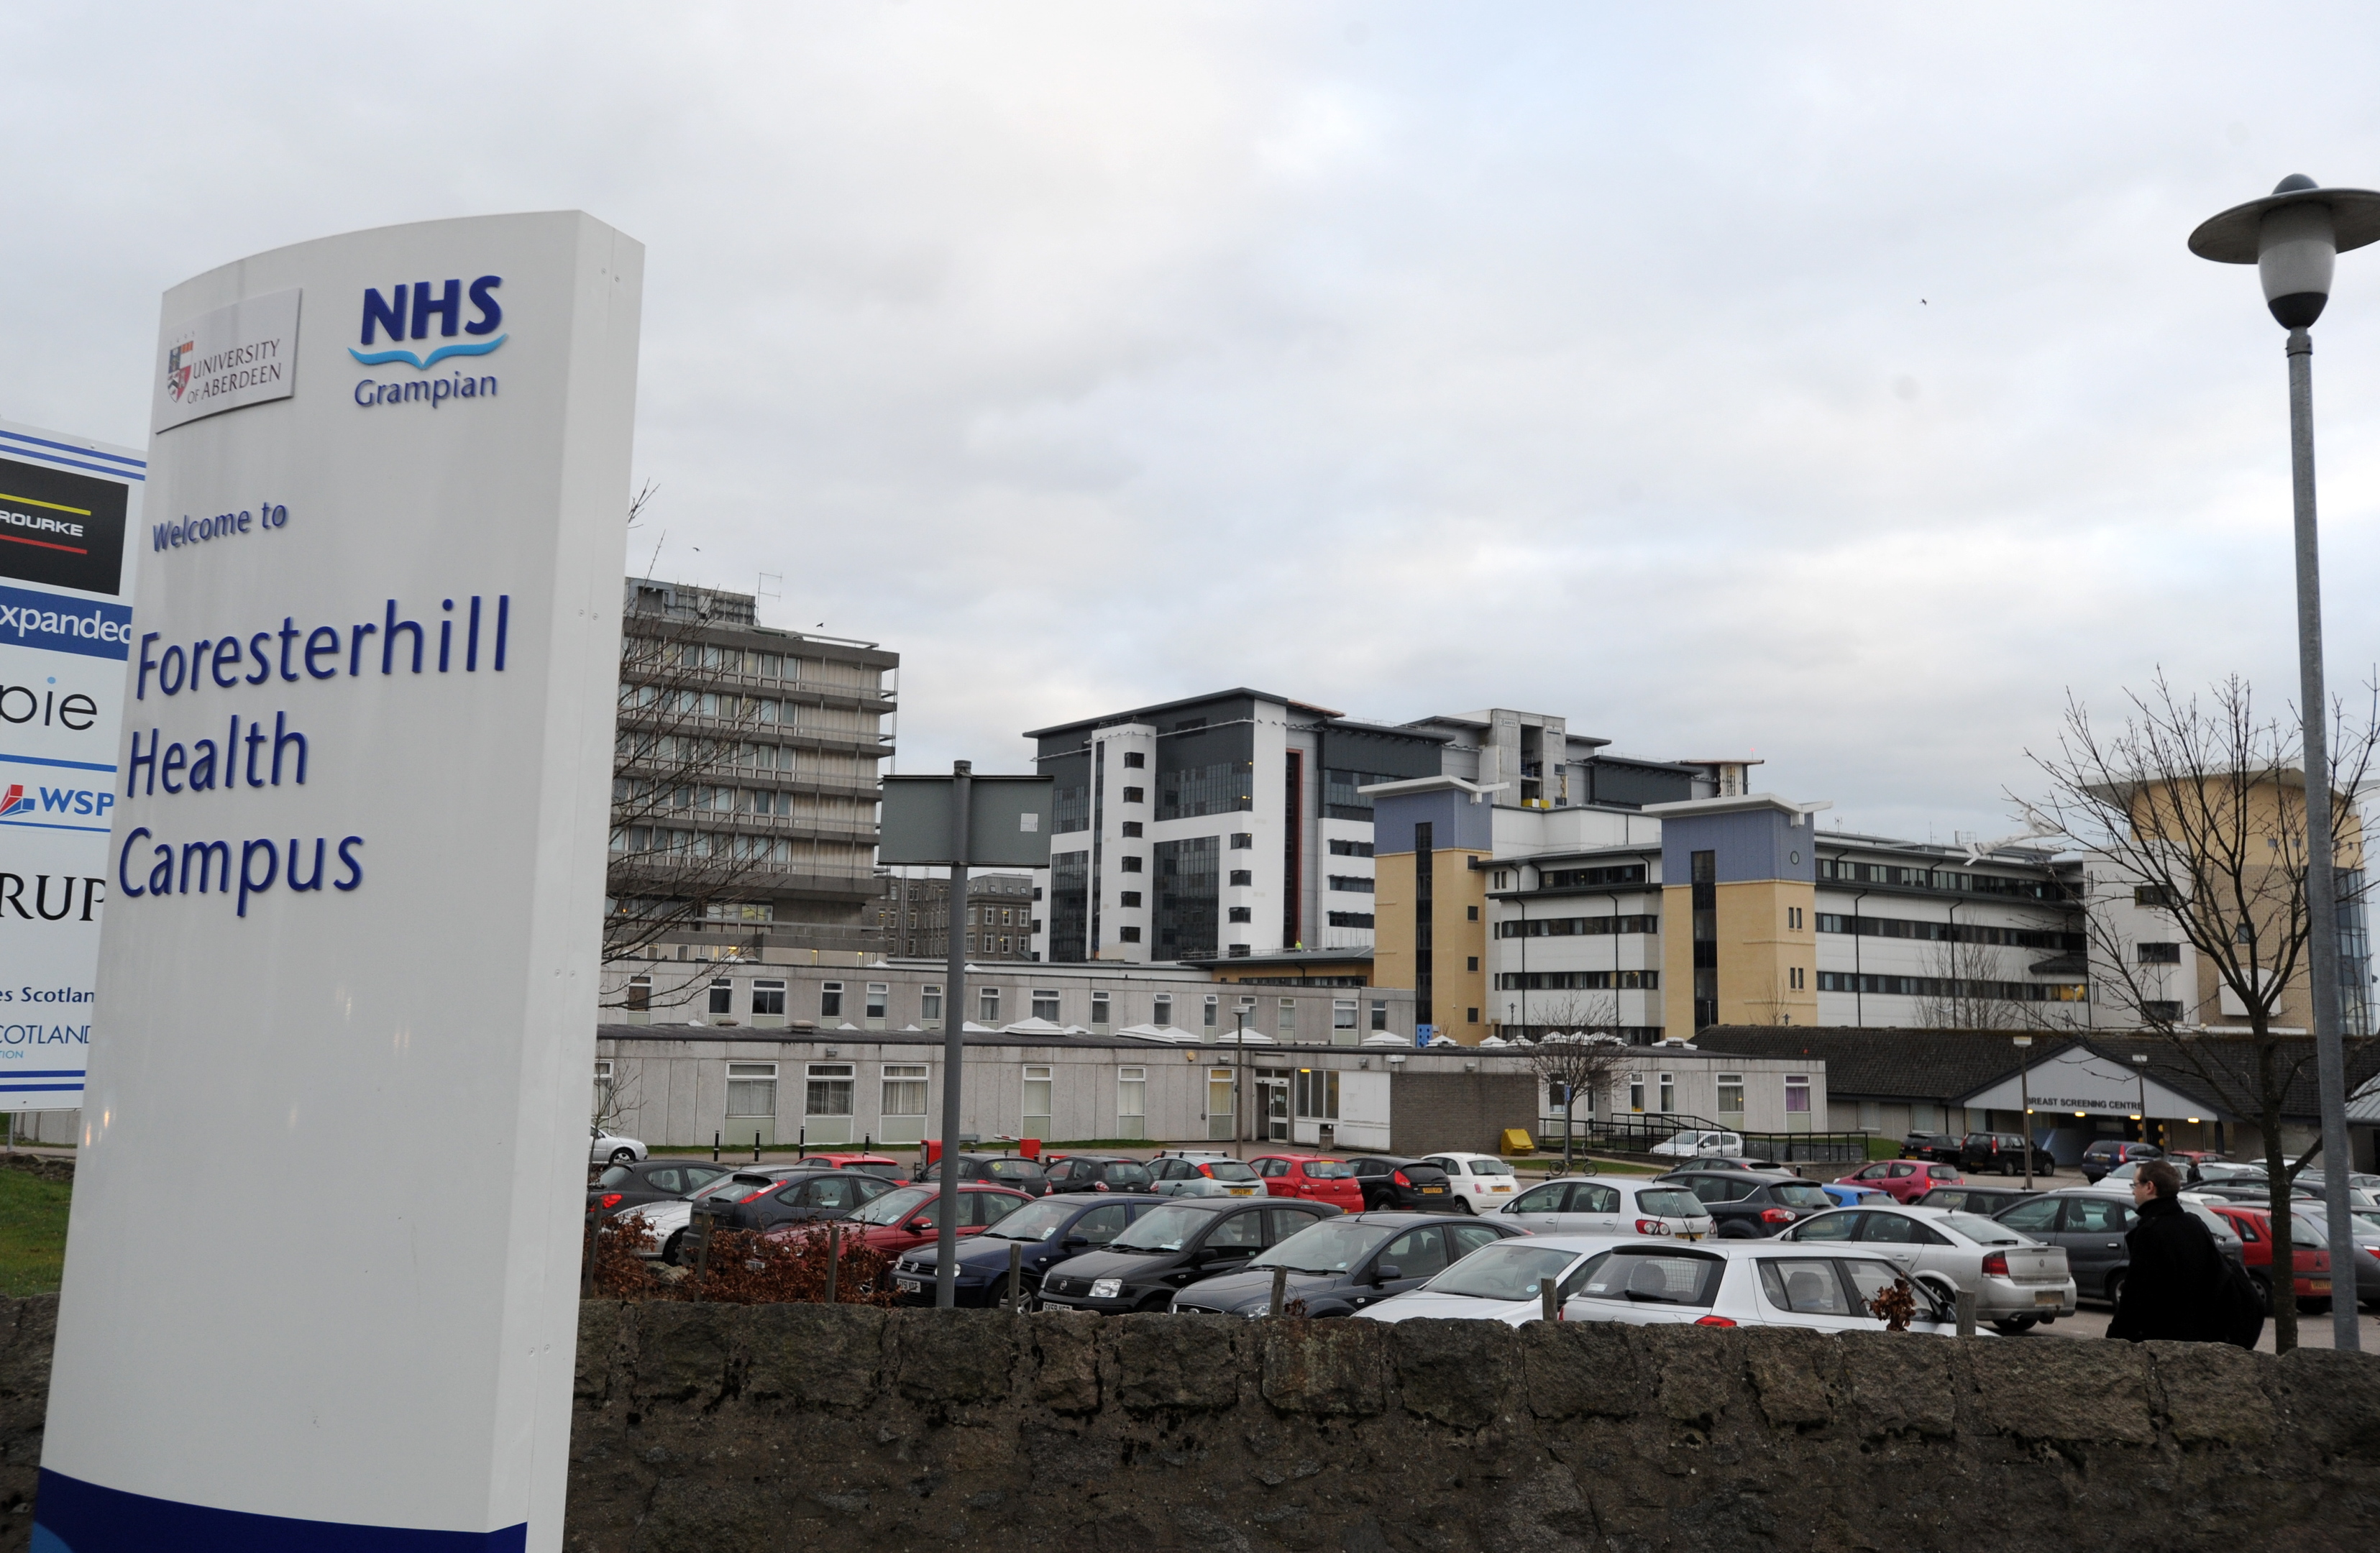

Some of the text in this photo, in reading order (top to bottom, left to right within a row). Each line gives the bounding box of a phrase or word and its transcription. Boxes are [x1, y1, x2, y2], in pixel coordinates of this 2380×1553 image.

[361, 275, 503, 345] NHS
[193, 339, 280, 379] UNIVERSITY
[187, 362, 281, 404] OF ABERDEEN
[354, 370, 498, 408] Grampian
[0, 510, 84, 537] ROURKE
[152, 502, 288, 552] Welcome to
[137, 595, 510, 700] Foresterhill
[127, 710, 309, 798] Health
[39, 787, 115, 817] WSP
[119, 827, 365, 917] Campus
[21, 986, 94, 1003] Scotlan
[0, 1025, 91, 1045] OTLAN
[0, 1050, 24, 1059] ION
[2027, 1096, 2142, 1110] BREAST SCREENING CENTRE
